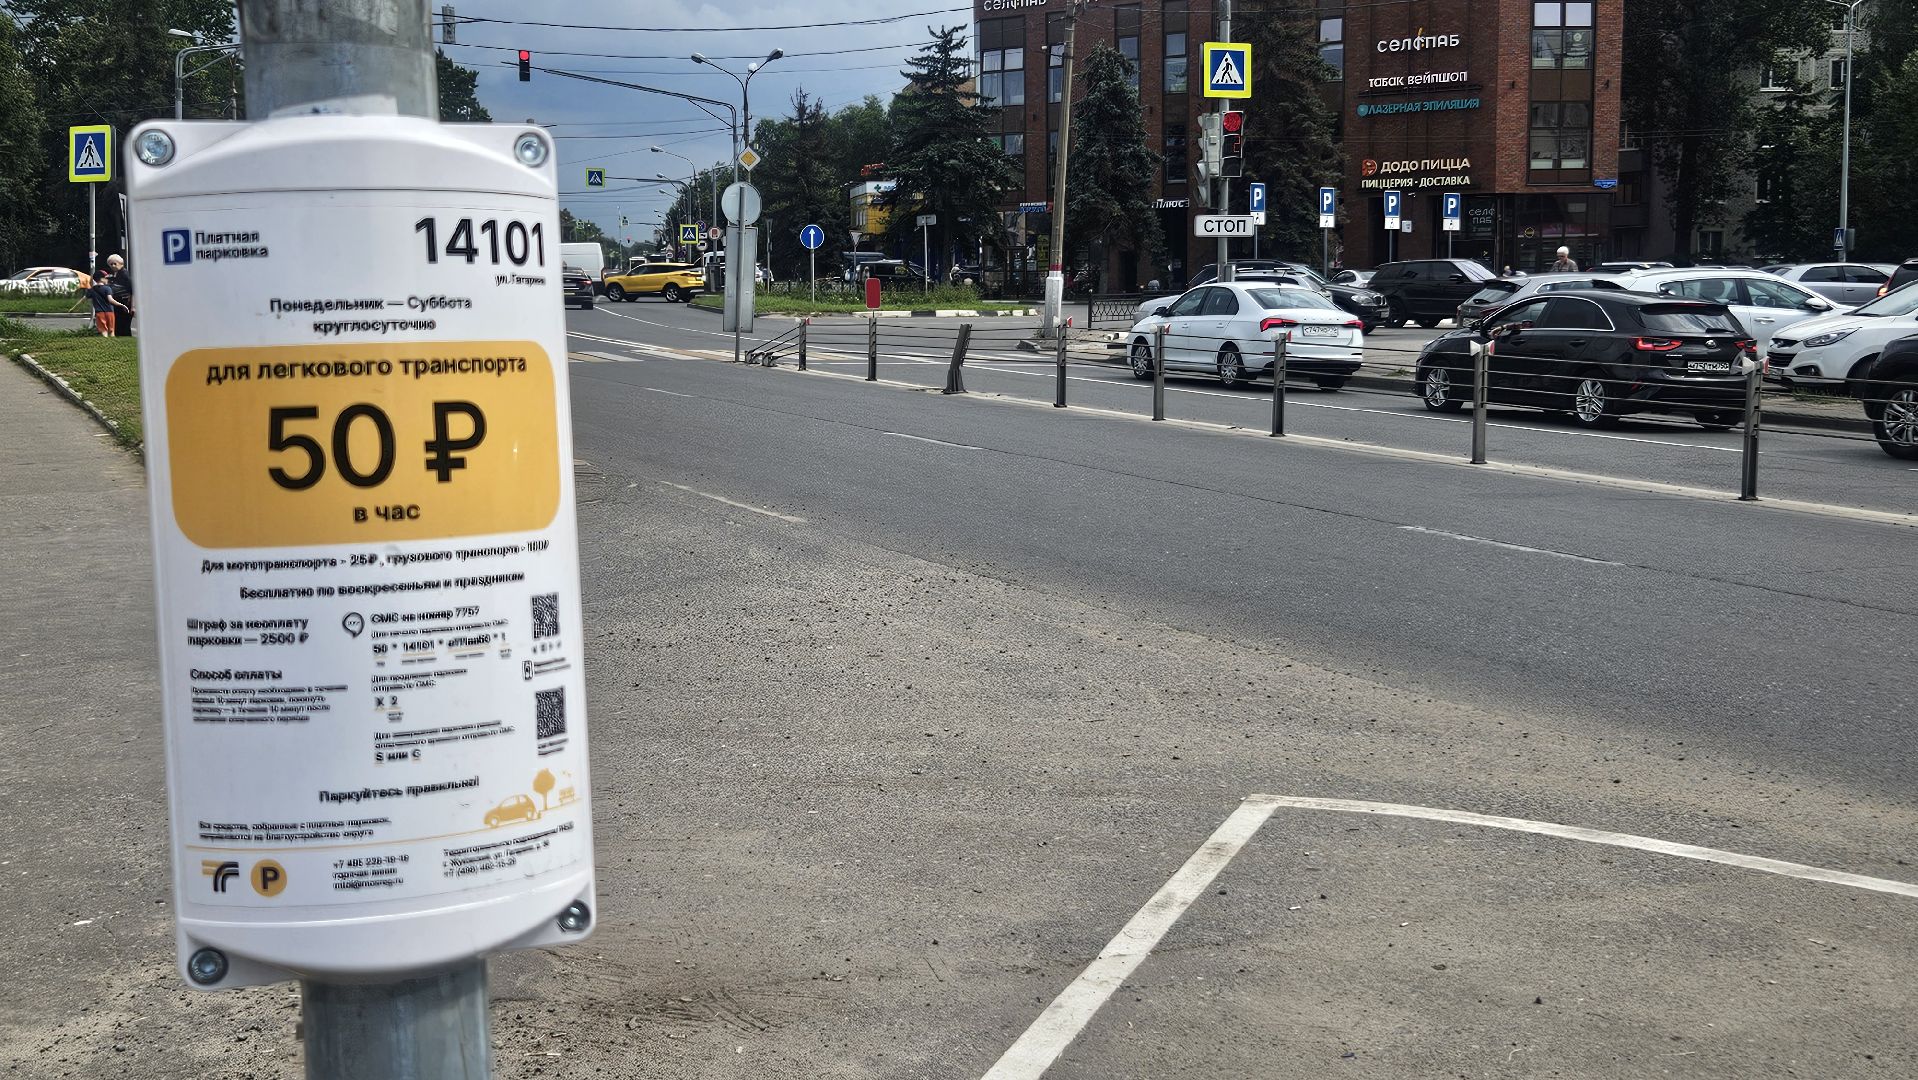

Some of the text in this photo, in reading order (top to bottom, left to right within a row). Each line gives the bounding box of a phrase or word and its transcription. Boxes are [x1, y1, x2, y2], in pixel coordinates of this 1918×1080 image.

[1369, 71, 1468, 87] табак вейпшоп
[1368, 98, 1479, 115] ЛАЗЕРНАЯ ЭПИЛЯЦИЯ
[1381, 158, 1471, 174] ДОДО ПИЦЦА
[1362, 178, 1413, 189] ПИЦЦЕРИЯ
[1419, 175, 1470, 187] ДОСТАВКА
[1204, 220, 1246, 232] СТОП
[195, 232, 259, 245] Платная
[415, 217, 545, 267] 14101
[195, 246, 269, 262] парковка
[270, 297, 384, 313] Понедельник
[407, 295, 472, 312] Суббота
[313, 319, 436, 336] круглосуточно
[207, 356, 527, 385] для легкового транспорта
[268, 402, 396, 491] 50
[353, 504, 421, 523] в час
[202, 559, 224, 574] Для
[227, 558, 337, 573] мототранспорта
[386, 552, 452, 566] грузового
[456, 545, 519, 562] транспорта
[240, 572, 525, 599] Бесплатно по воскресеньям и праздникам
[371, 606, 480, 625] СМС на номер 7757
[187, 618, 309, 632] Штраф за неоплату
[188, 635, 242, 649] парковки
[260, 632, 295, 645] 2500
[190, 669, 282, 681] Способ оплаты
[376, 751, 384, 762] S
[387, 751, 408, 761] или
[319, 786, 403, 804] Паркуйтесь
